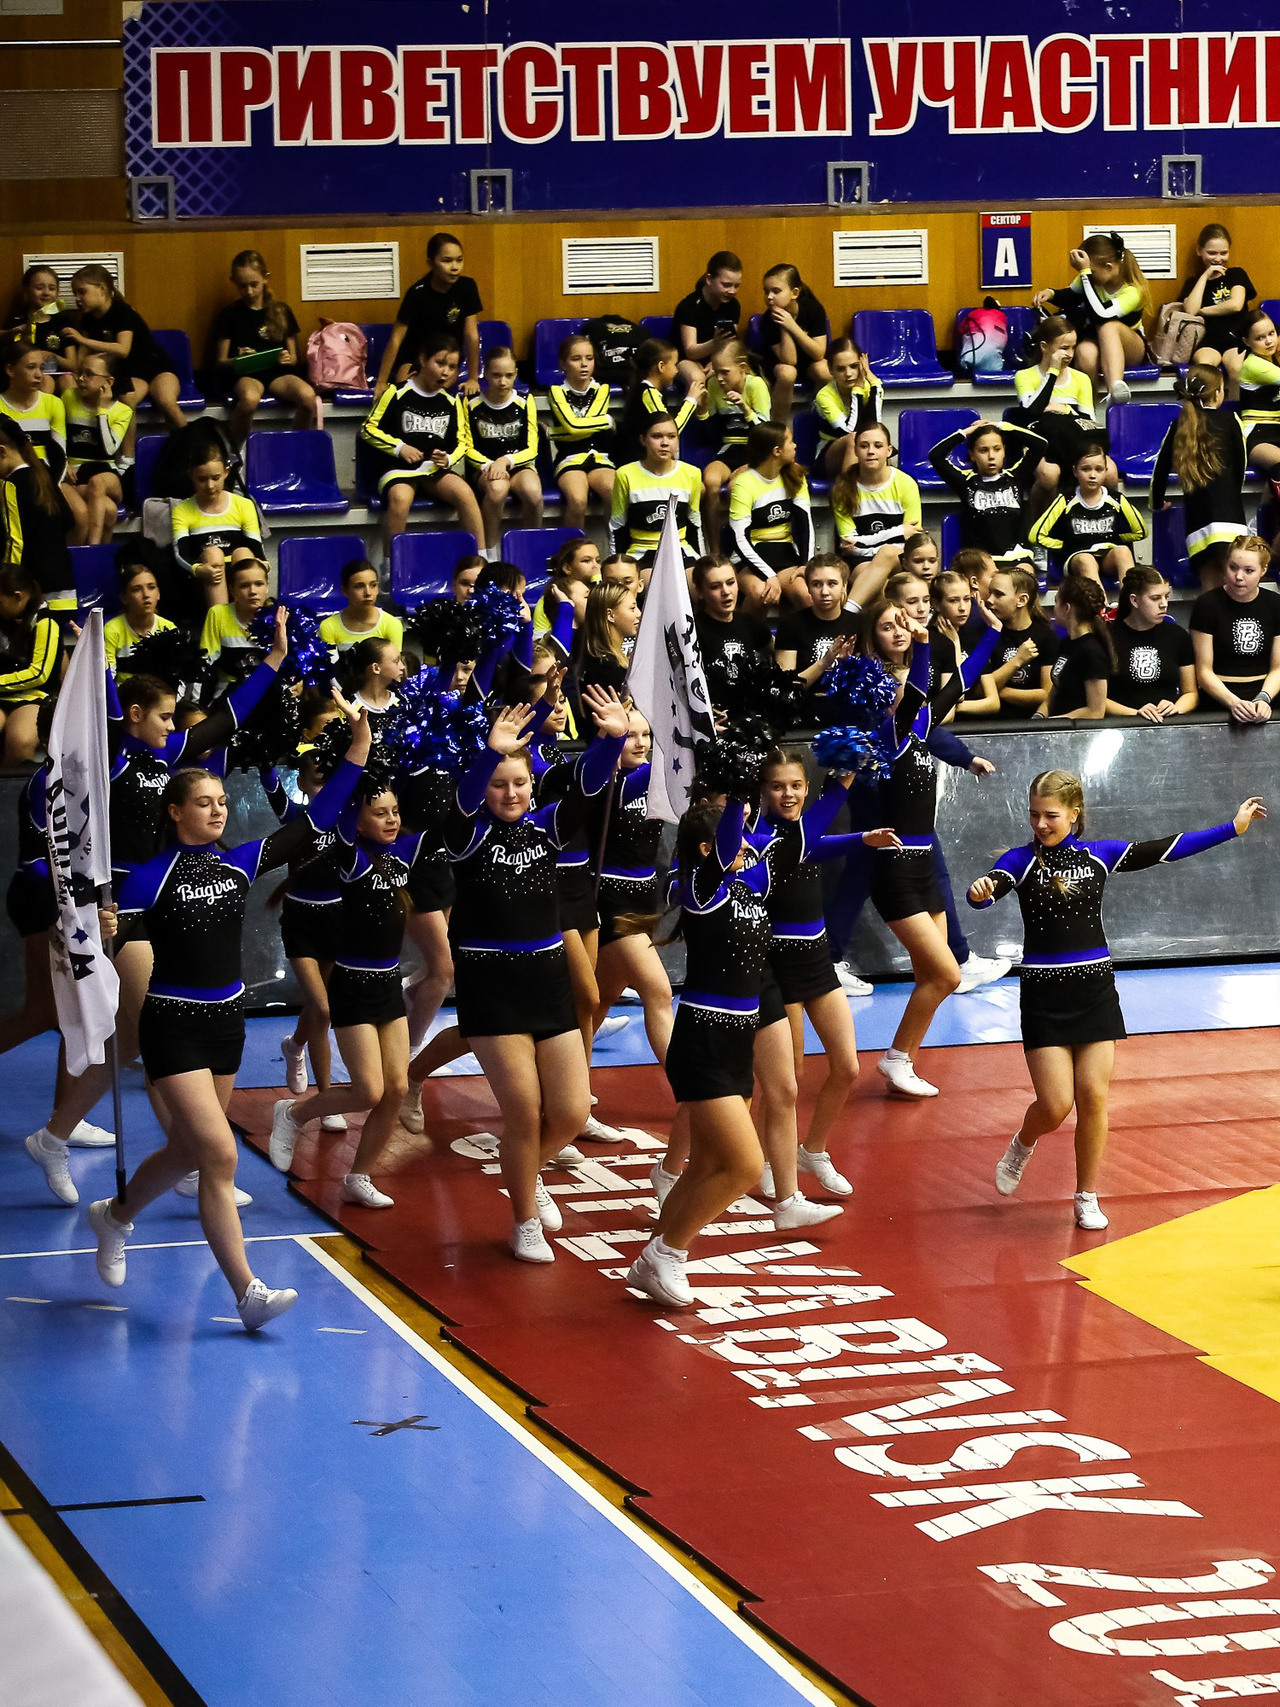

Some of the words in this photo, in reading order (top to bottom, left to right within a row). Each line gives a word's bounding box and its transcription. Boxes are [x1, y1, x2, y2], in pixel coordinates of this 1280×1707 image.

[151, 38, 852, 148] ПРИВЕТСТВУЕМ
[990, 214, 1021, 225] СЕКТОР
[402, 411, 450, 439] GRACE
[478, 419, 523, 439] GRACE
[1072, 516, 1116, 534] GRACE
[491, 844, 547, 874] Bagira
[177, 877, 238, 905] Bagira
